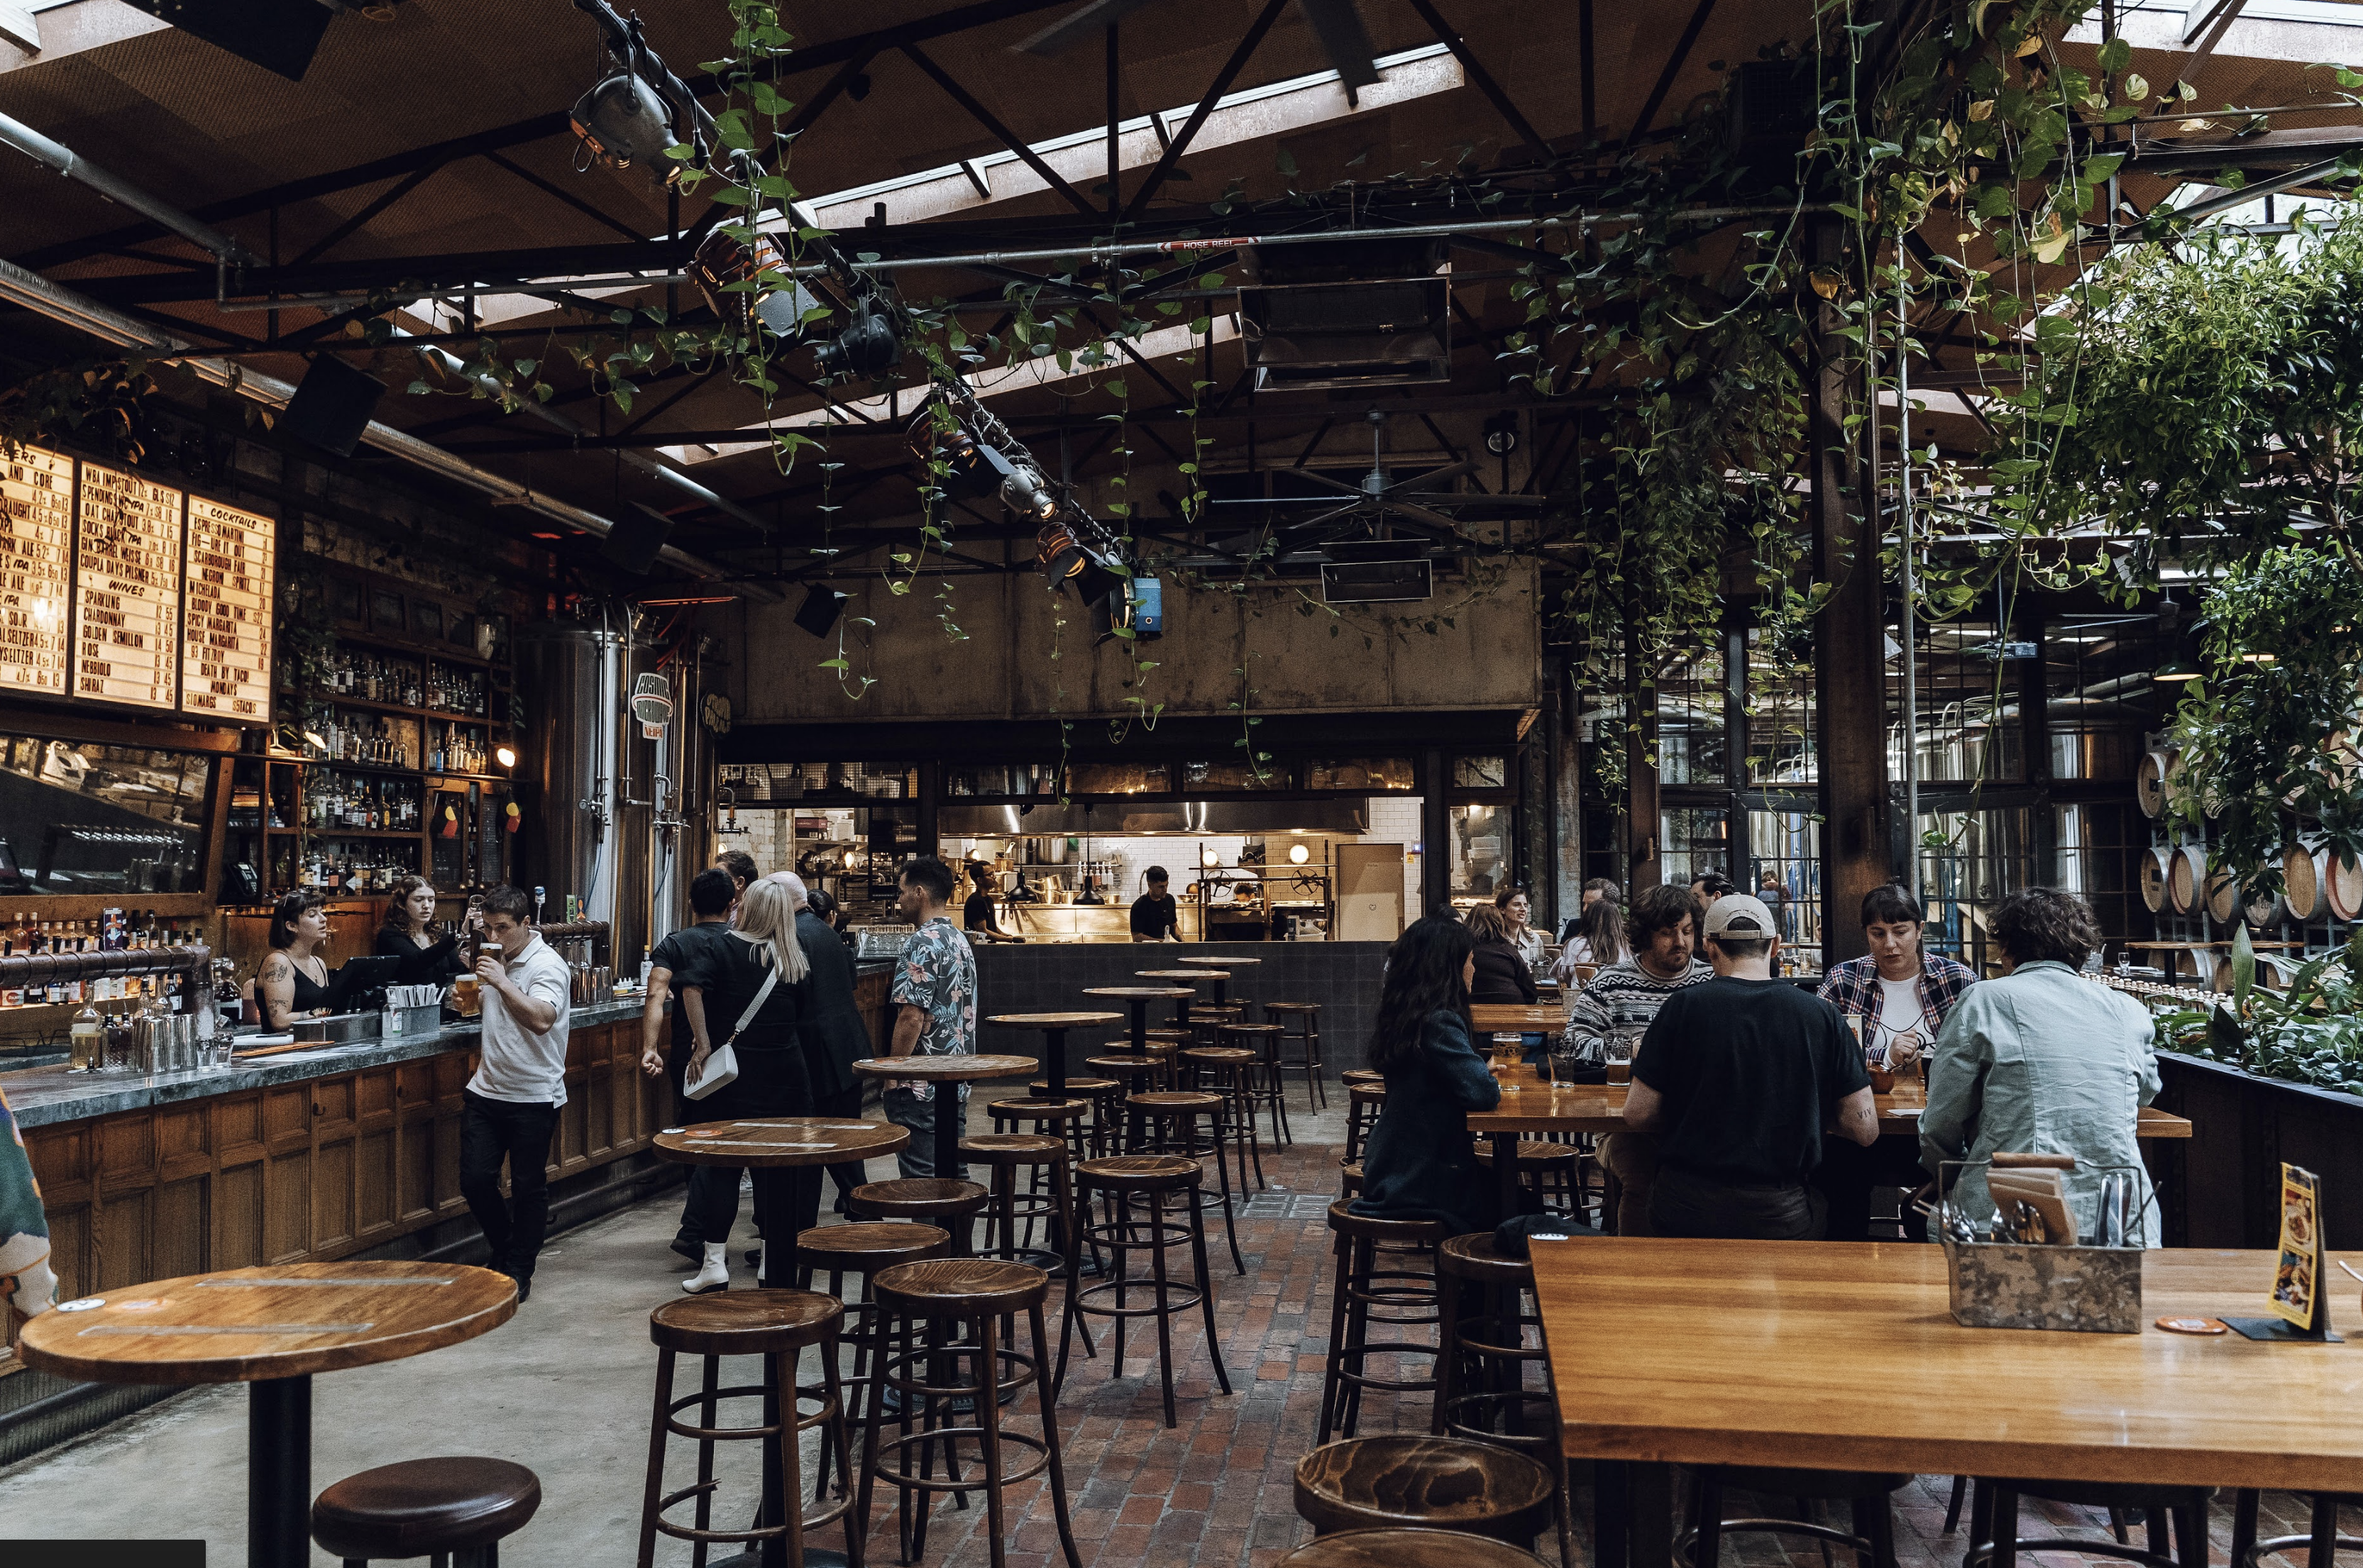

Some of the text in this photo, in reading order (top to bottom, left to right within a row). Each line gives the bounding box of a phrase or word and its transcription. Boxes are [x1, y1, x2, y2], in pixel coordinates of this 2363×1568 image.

[1183, 239, 1235, 250] HOSE REEL
[9, 464, 53, 490] AND CORE
[86, 467, 100, 484] WBA
[102, 472, 116, 489] IMP
[117, 477, 137, 495] STOUT
[62, 497, 68, 512] 13
[166, 508, 172, 523] 16
[62, 514, 68, 529] 13
[85, 503, 99, 519] OAT
[167, 525, 172, 539] 15
[211, 507, 257, 529] COCKTAILS
[61, 532, 67, 546] 13
[82, 519, 103, 537] SOCKS
[170, 542, 177, 557] 16
[194, 517, 221, 536] ESPRESSO
[222, 525, 244, 544] MARTINI
[22, 541, 34, 557] ALE
[62, 550, 69, 565] 14
[82, 536, 92, 553] GIN
[121, 546, 141, 565] WEISSE
[170, 558, 175, 572] 16
[224, 541, 228, 554] IT
[234, 544, 245, 558] OUT
[13, 559, 28, 572] IPA
[61, 568, 67, 582] 13
[80, 553, 104, 573] COUPLA
[107, 560, 123, 577] DAYS
[125, 565, 149, 584] PILSNER
[194, 550, 232, 571] SCARBOROUGH
[234, 560, 246, 575] FAIR
[11, 575, 24, 590] ALE
[109, 580, 145, 597] WINES
[232, 575, 250, 592] SPRITZ
[260, 582, 265, 595] 17
[4, 595, 19, 607] IPA
[85, 590, 172, 621] SPARKLING 12 55
[189, 580, 265, 610] MICHELADA 20
[9, 611, 27, 628] SOUR
[192, 597, 212, 614] BLOODY
[216, 602, 229, 617] GOOD
[234, 607, 246, 621] TIME
[84, 607, 172, 637] CHARDONNAY 13 45
[187, 612, 266, 639] SPICY MARGARITA 24
[57, 637, 65, 652] 14
[83, 624, 173, 653] GOLDEN SEMILLON 14 50
[187, 628, 267, 656] HOUSE MARGARITA 22
[58, 655, 65, 670] 14
[82, 641, 172, 670] ROSE 13 45
[191, 645, 198, 658] 93
[258, 658, 264, 670] 19
[53, 672, 60, 687] 13
[82, 659, 171, 686] NEBBIOLO 13 45
[201, 663, 217, 678] DEATH
[221, 666, 229, 680] BY
[80, 677, 173, 702] SHIRAZ 13 45
[211, 680, 237, 696] MONDAYS
[637, 675, 671, 701] COSMIC
